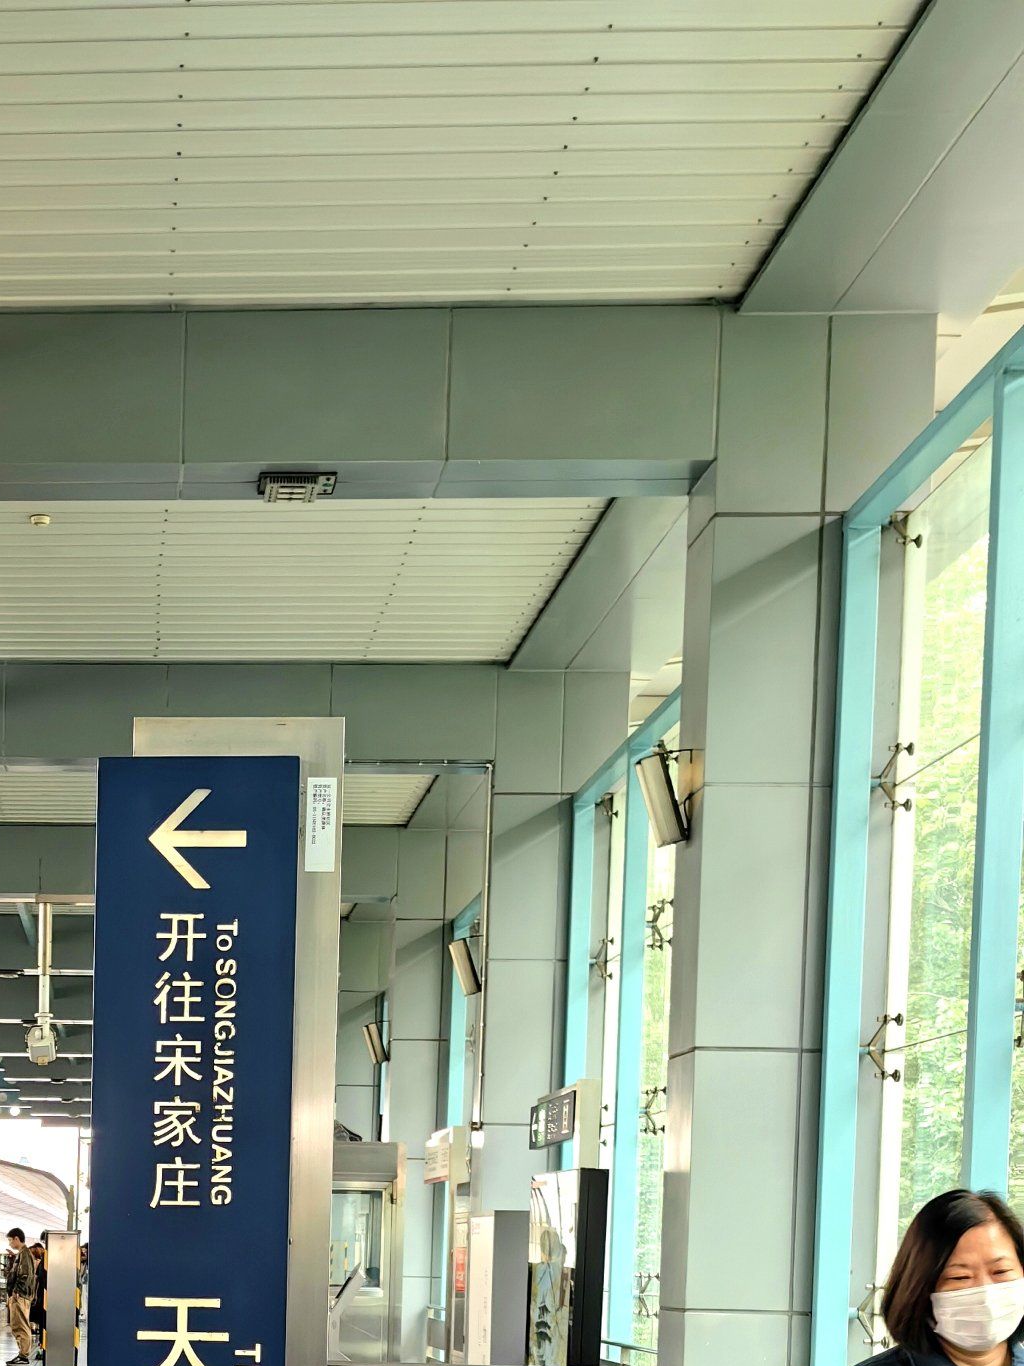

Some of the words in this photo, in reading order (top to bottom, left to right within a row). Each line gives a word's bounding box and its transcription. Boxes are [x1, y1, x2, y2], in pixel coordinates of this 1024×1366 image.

[215, 918, 238, 952] To
[149, 912, 207, 1208] 开往宋家庄
[210, 957, 237, 1206] SONGJIAZHUANG
